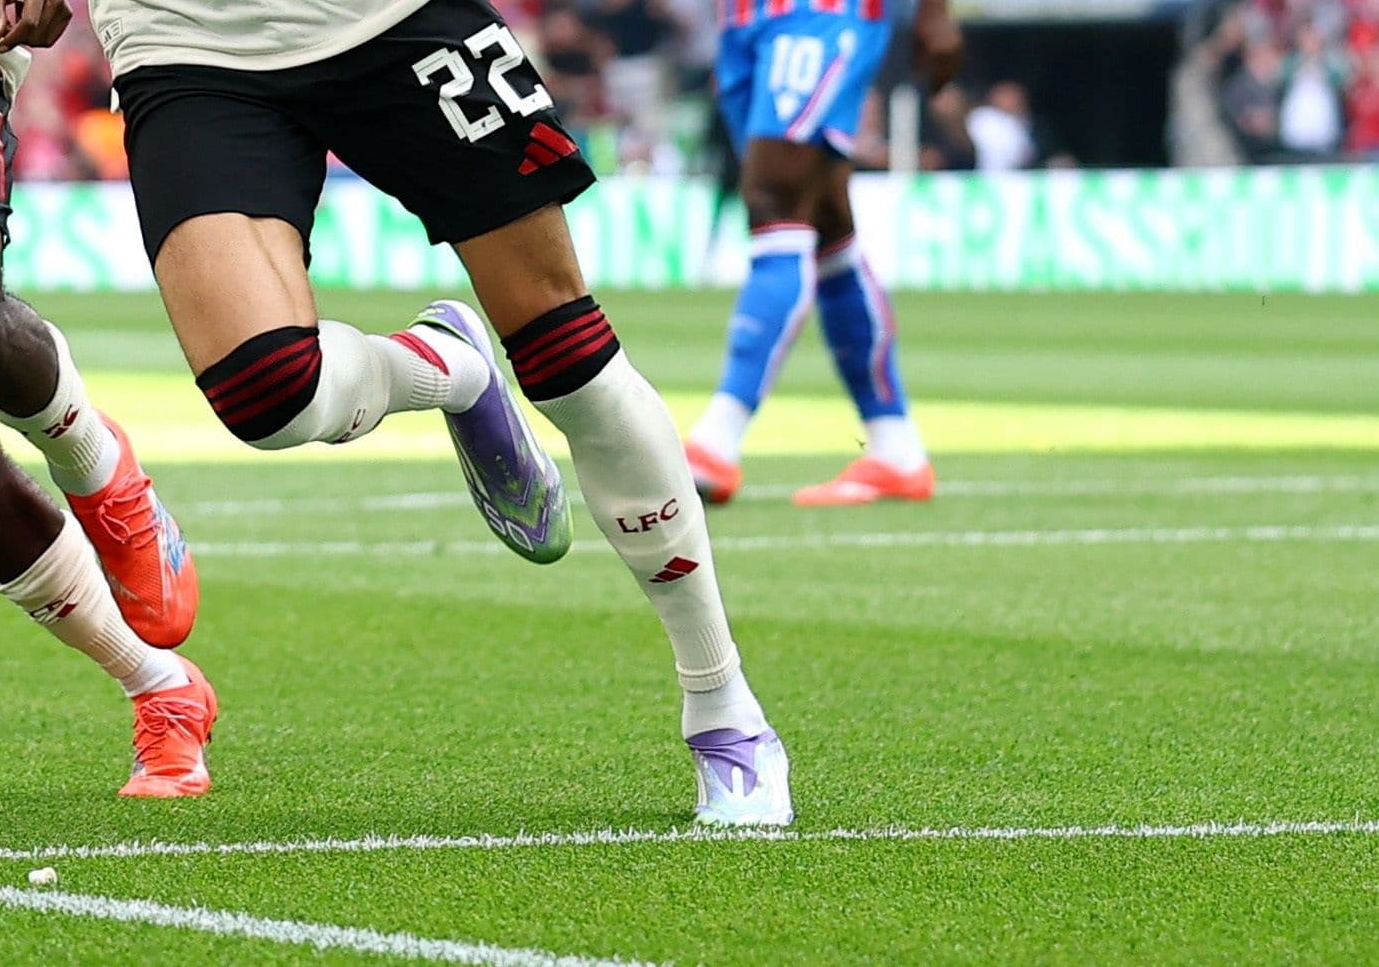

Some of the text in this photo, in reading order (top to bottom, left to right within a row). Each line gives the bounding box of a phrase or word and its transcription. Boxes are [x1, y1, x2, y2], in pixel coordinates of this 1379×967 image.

[411, 22, 555, 144] 22
[769, 34, 825, 92] 10
[615, 498, 679, 533] LFC
